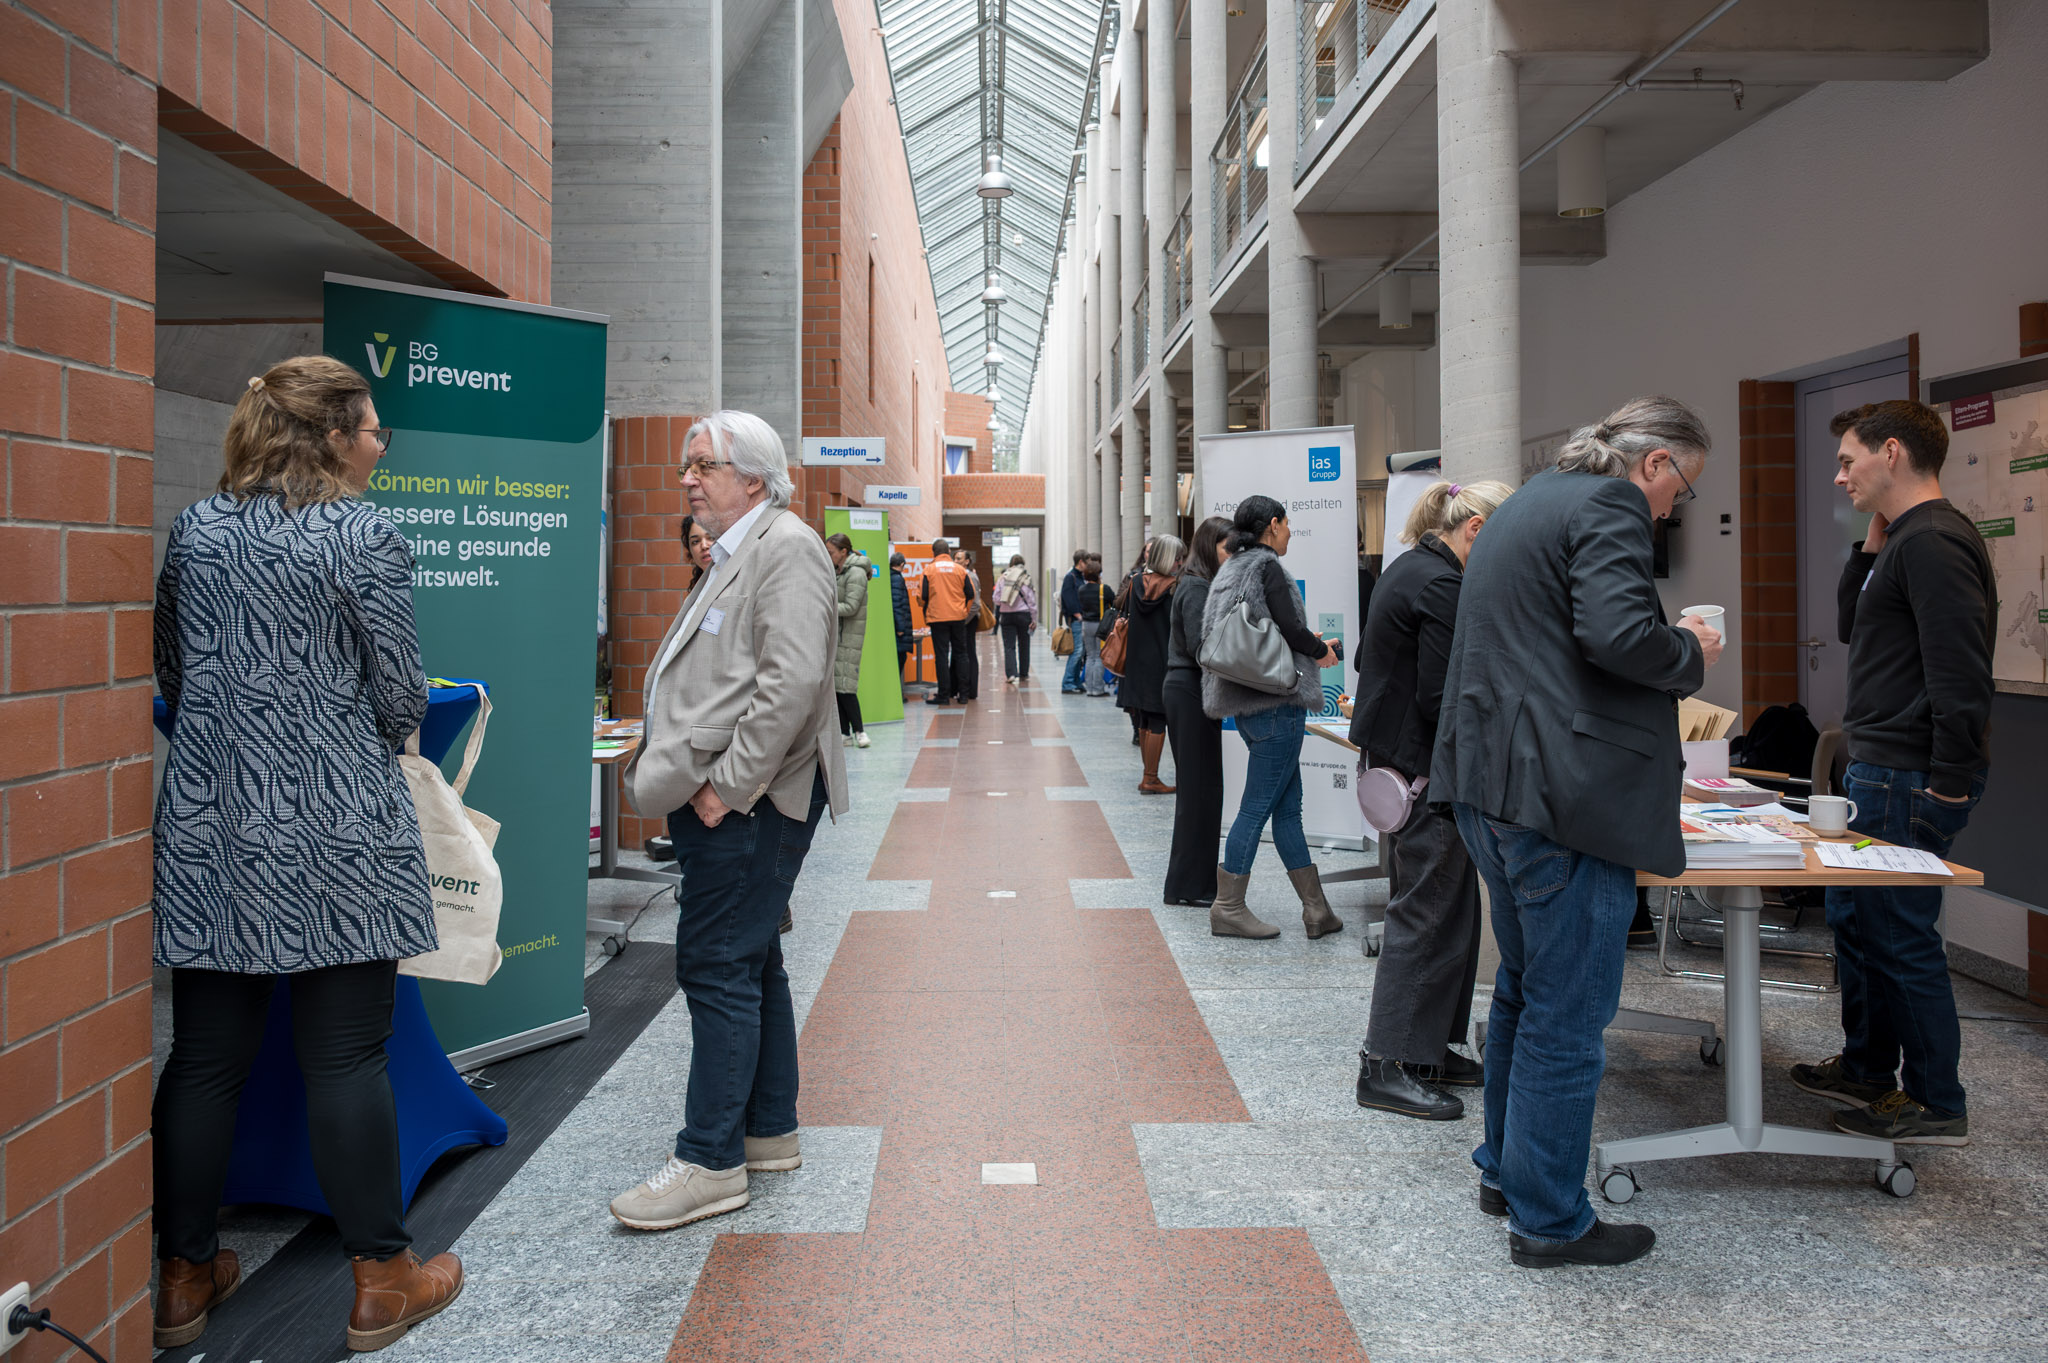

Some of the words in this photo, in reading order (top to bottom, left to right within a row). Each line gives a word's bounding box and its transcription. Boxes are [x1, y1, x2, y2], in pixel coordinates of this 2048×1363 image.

[409, 341, 438, 361] BG
[408, 361, 511, 392] prevent
[820, 446, 867, 458] Rezeption
[1312, 456, 1331, 470] ias
[1312, 471, 1336, 480] Gruppe
[457, 474, 489, 496] wir
[495, 476, 570, 500] besser:
[878, 490, 908, 500] Kapelle
[1214, 500, 1240, 512] Arbe
[1292, 498, 1342, 512] gestalten
[464, 504, 568, 532] Lösungen
[458, 536, 551, 560] gesunde
[429, 873, 480, 896] vent
[436, 900, 476, 913] gemacht.
